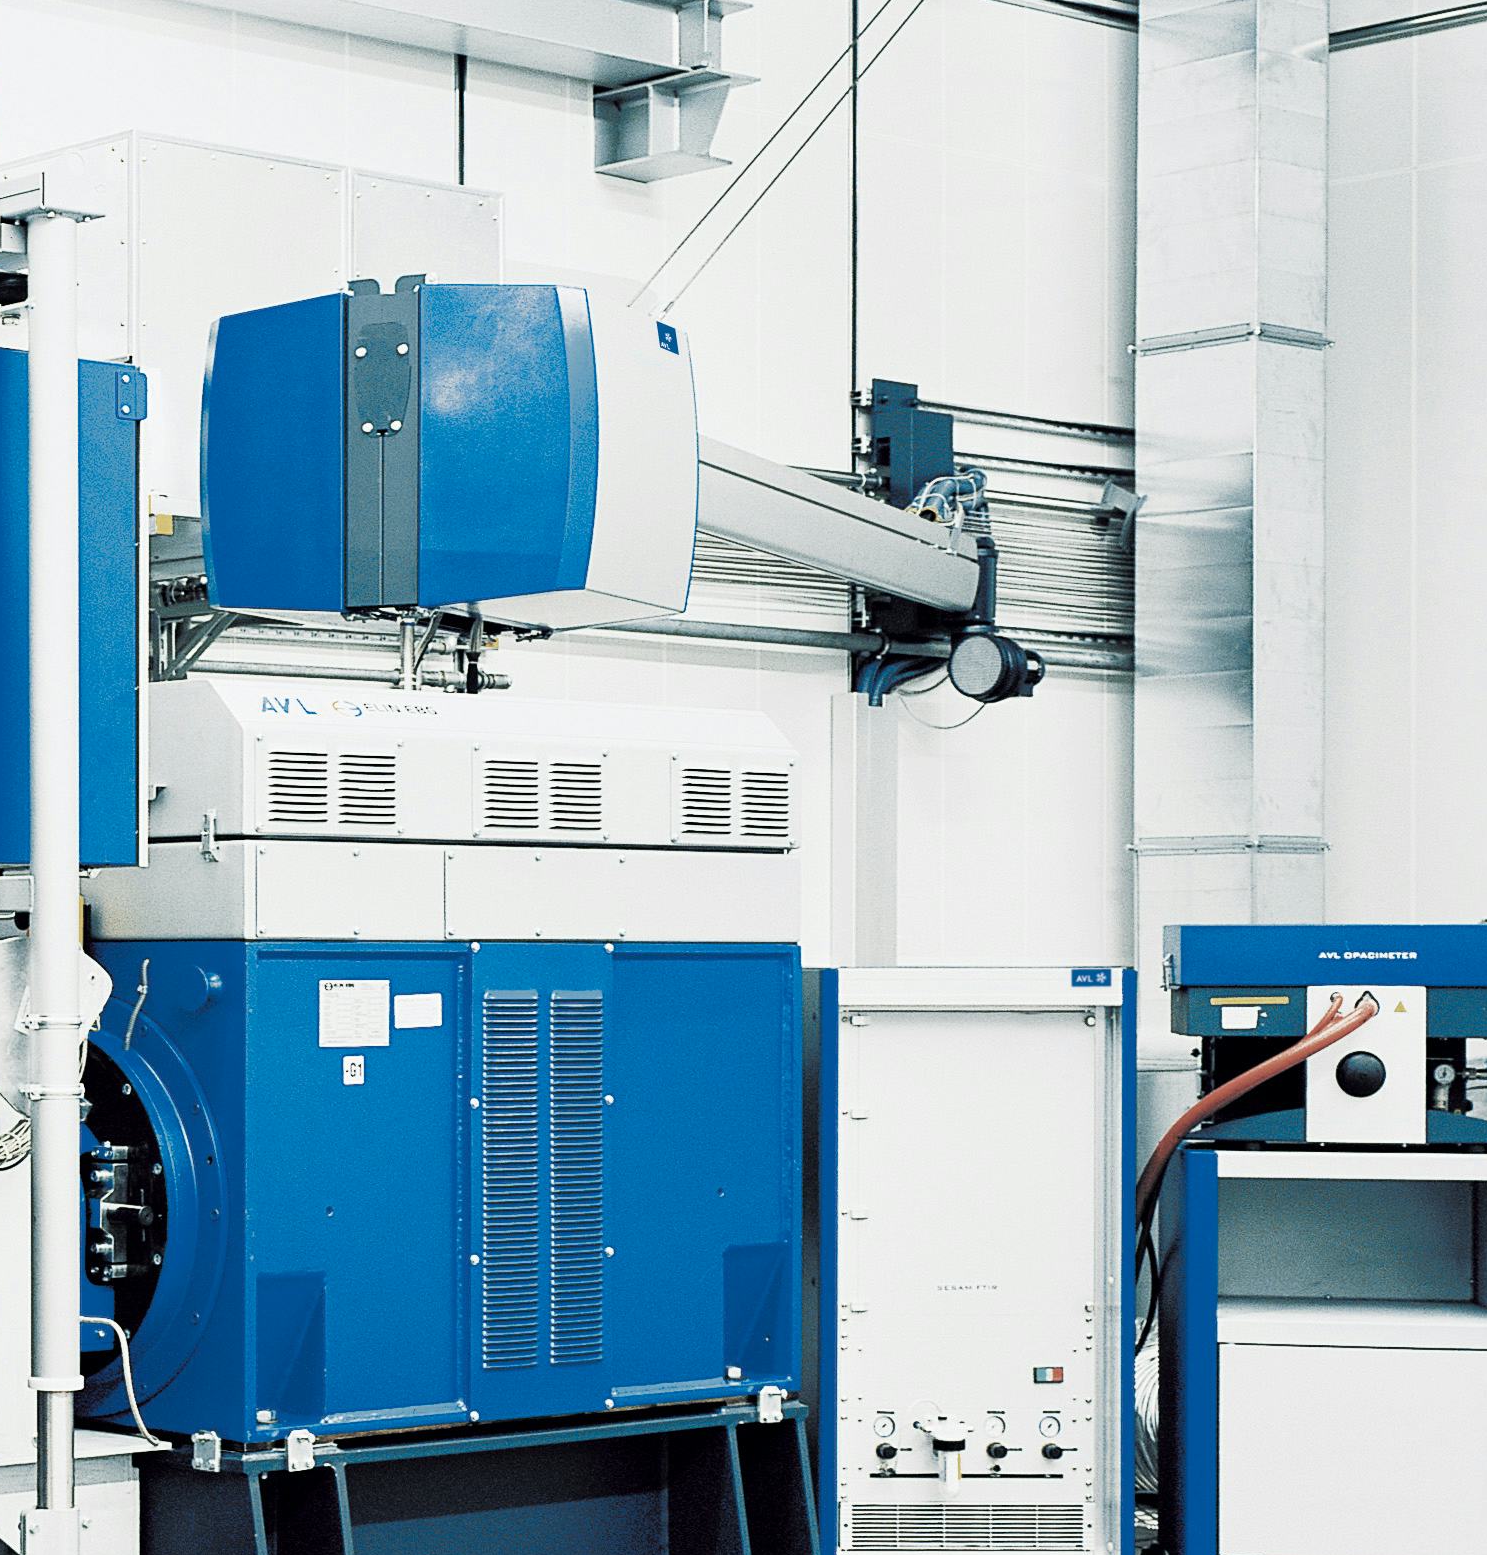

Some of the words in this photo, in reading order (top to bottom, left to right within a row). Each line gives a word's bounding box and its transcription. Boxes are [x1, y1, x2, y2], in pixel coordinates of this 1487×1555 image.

[261, 696, 318, 715] AVL
[1318, 951, 1342, 960] AVL
[1343, 951, 1418, 960] OPACIMETER
[1075, 975, 1094, 983] AVL
